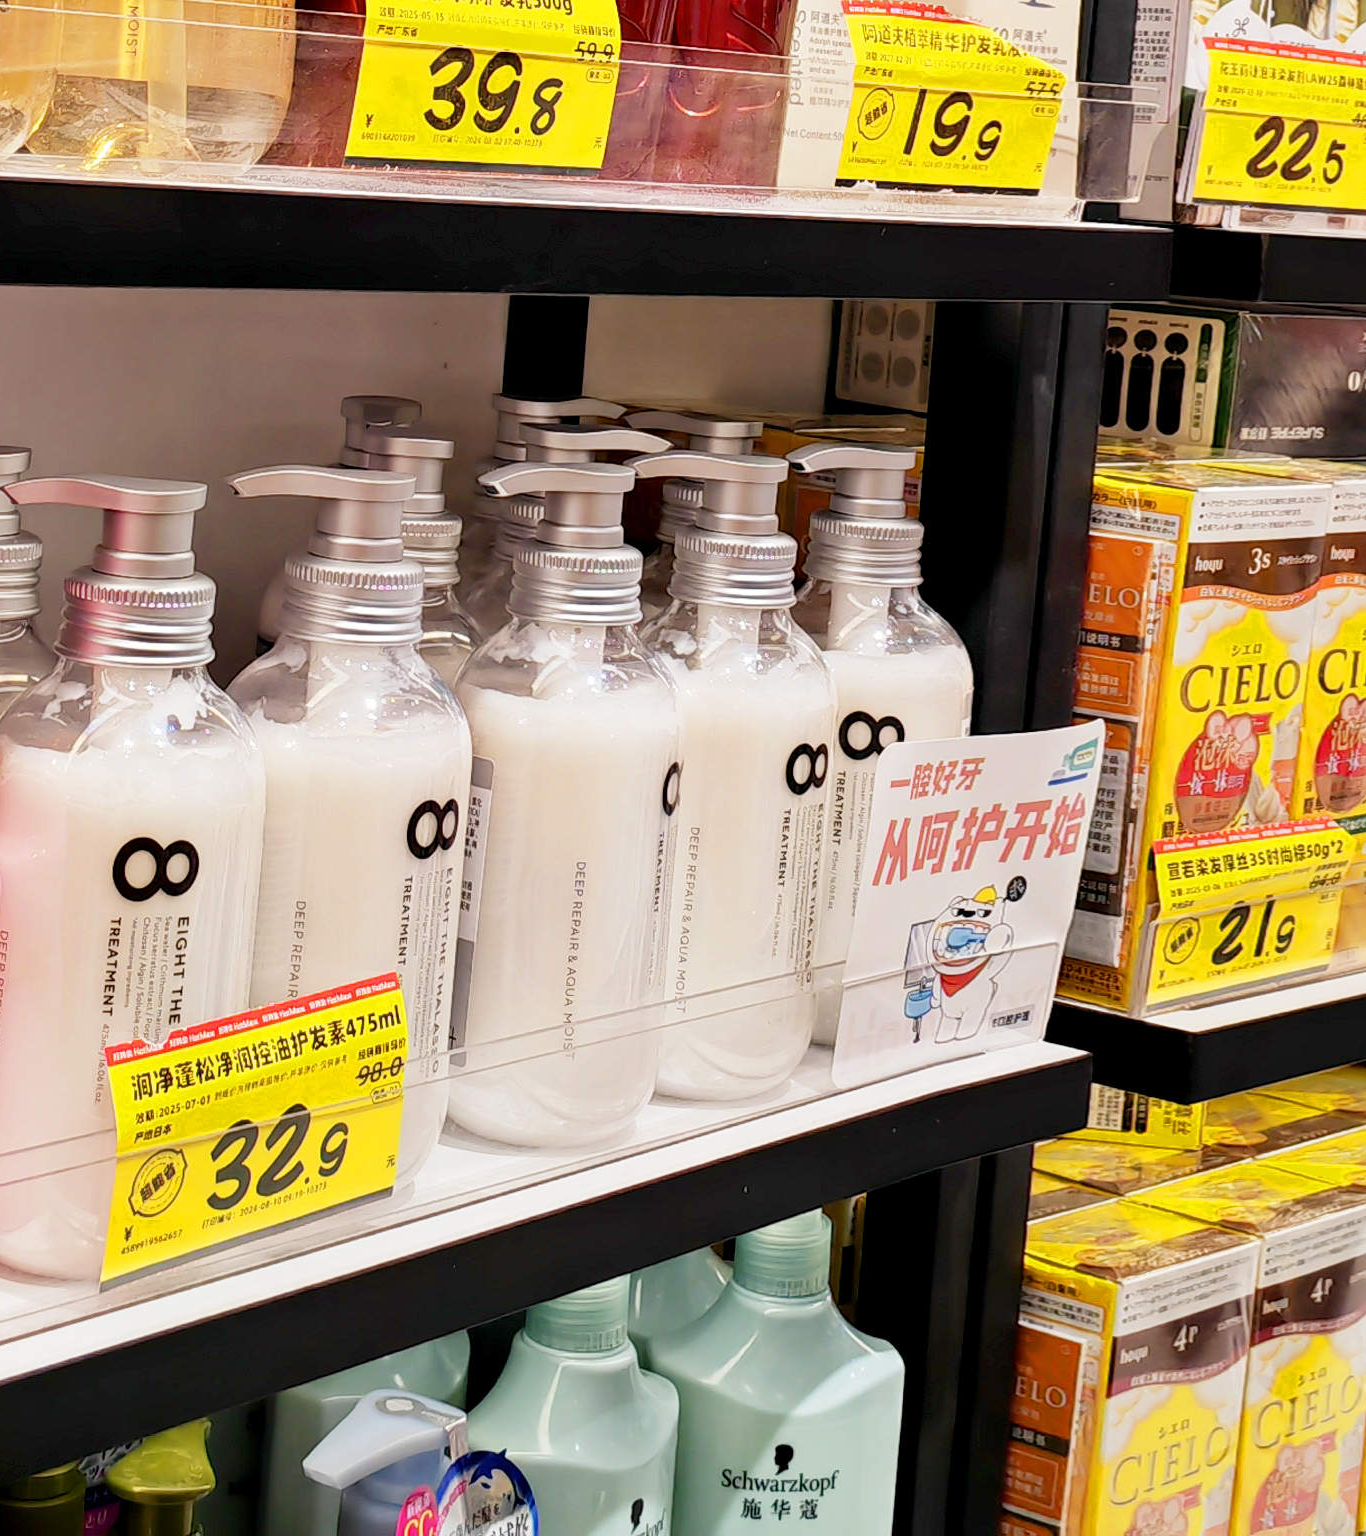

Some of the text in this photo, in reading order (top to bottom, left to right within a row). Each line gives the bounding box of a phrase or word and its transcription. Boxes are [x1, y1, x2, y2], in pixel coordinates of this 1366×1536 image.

[126, 6, 141, 58] MOIST
[423, 46, 564, 137] 39.8
[903, 88, 1002, 163] 19.9
[1245, 115, 1347, 185] 22.5
[1179, 659, 1301, 713] CIELO
[1230, 643, 1263, 657] シエロ
[831, 770, 846, 847] TREATMENT
[889, 757, 986, 801] 一腔好牙
[777, 807, 792, 888] TREATMENT
[871, 792, 1088, 887] 从呵护开始
[397, 875, 414, 967] TREATMENT
[563, 860, 587, 1008] DEEP REPAIR AQUA
[678, 826, 701, 965] DEEP REPAIR AQUA
[1211, 894, 1297, 966] 21.9
[102, 916, 122, 1017] TREATMENT
[168, 916, 190, 1025] EIGHT THE
[287, 899, 308, 999] DEEP REPAIR
[206, 1102, 349, 1212] 32.9
[1252, 1373, 1363, 1450] CIELO
[720, 1466, 841, 1496] Schwarzkopf
[1109, 1423, 1233, 1506] CIELO
[741, 1497, 819, 1523] 施华蔻
